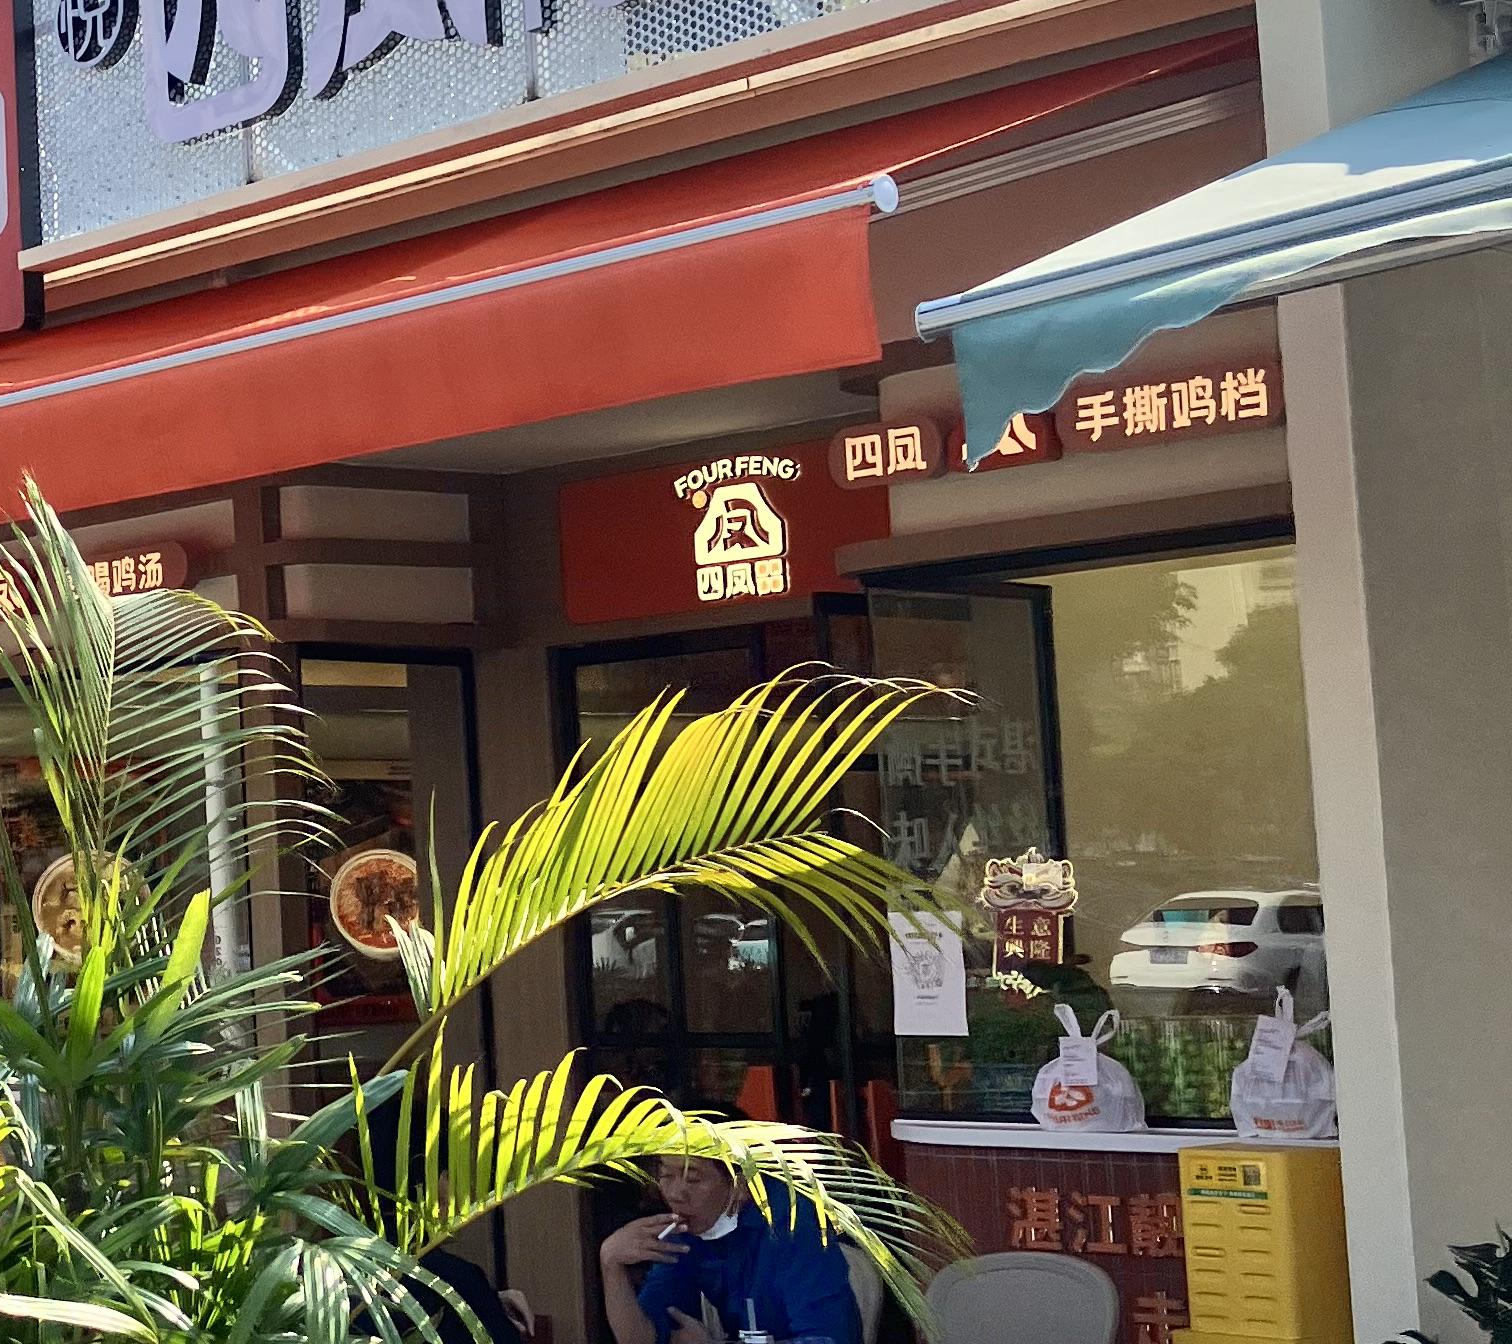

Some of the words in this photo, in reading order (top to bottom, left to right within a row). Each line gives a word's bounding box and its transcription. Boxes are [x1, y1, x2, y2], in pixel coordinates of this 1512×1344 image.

[1075, 367, 1268, 442] 手撕鸡档
[673, 457, 734, 499] FOUR
[734, 455, 798, 480] FENG
[845, 426, 927, 481] 四凤
[65, 552, 163, 599] 喝鸡汤
